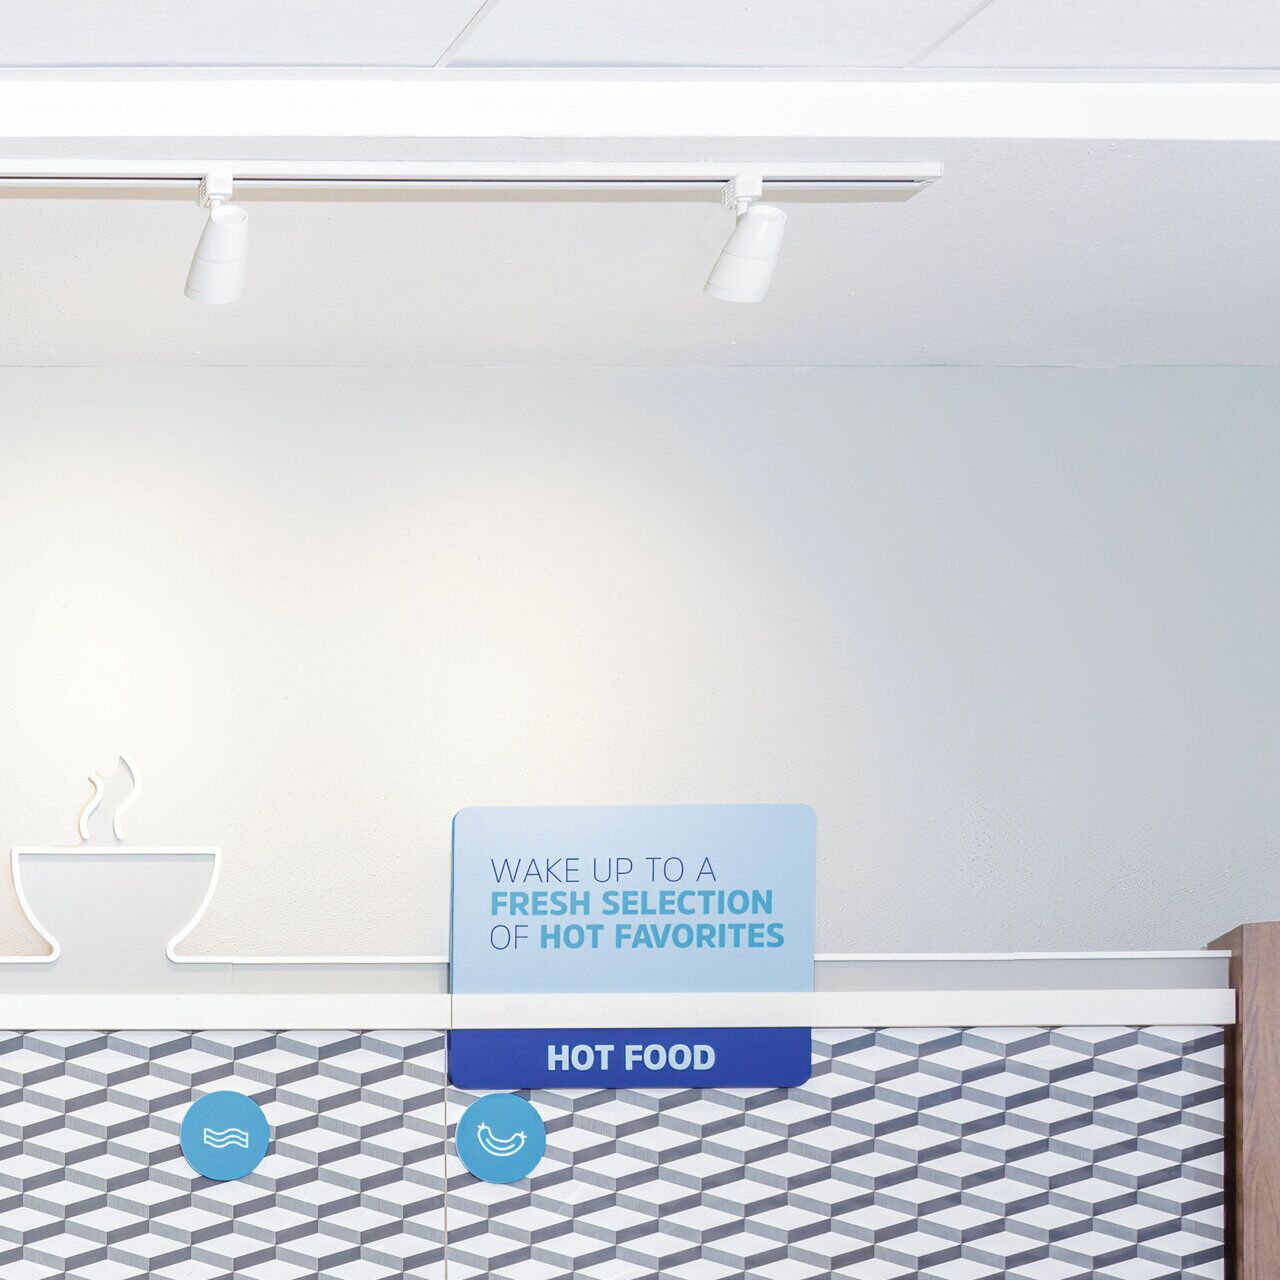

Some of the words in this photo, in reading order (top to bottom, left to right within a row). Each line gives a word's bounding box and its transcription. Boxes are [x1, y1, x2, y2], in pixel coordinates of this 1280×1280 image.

[490, 858, 580, 883] WAKE
[592, 857, 633, 883] UP
[645, 857, 684, 882] TO
[695, 856, 717, 882] A
[491, 890, 590, 916] FRESH
[601, 889, 773, 915] SELECTION
[490, 924, 529, 950] OF
[540, 924, 604, 949] HOT
[615, 922, 785, 949] FAVORITES
[547, 1044, 614, 1071] HOT
[625, 1044, 716, 1070] FOOD
